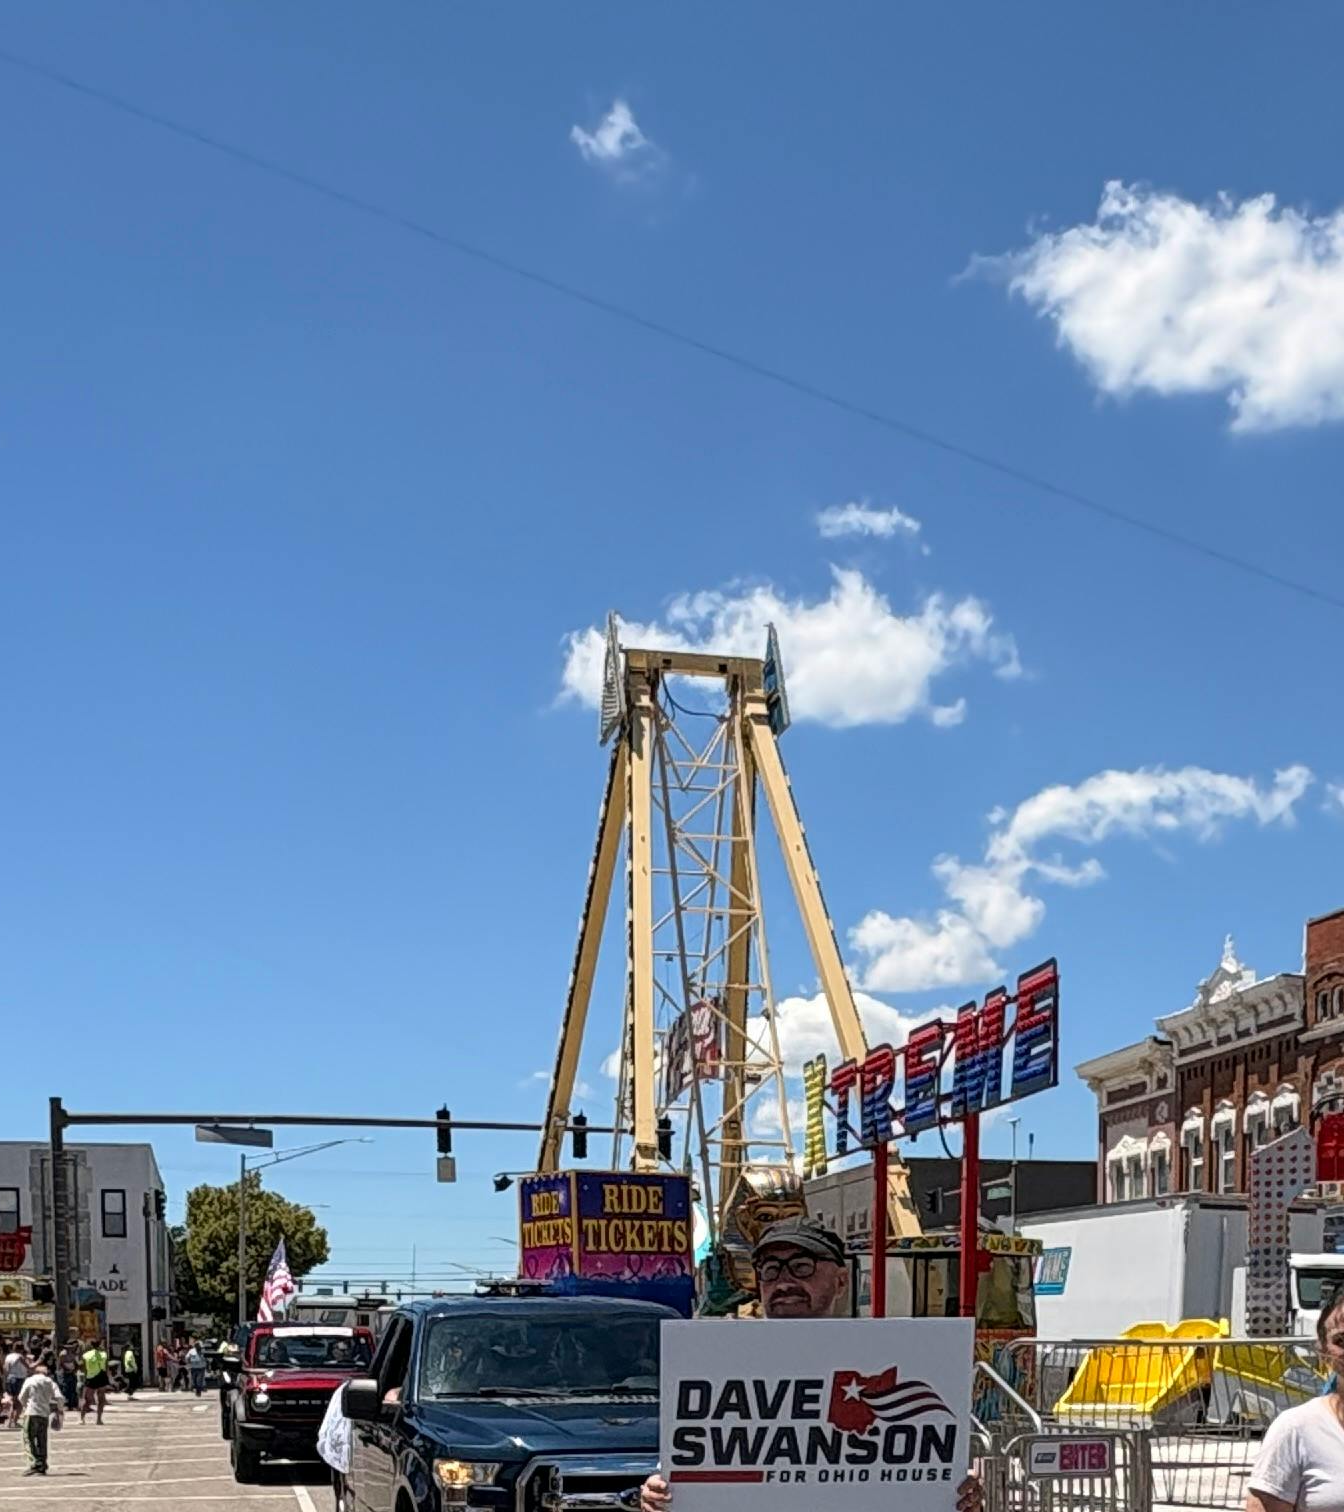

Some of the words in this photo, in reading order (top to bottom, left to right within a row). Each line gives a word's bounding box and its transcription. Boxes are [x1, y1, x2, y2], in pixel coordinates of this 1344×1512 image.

[530, 1191, 559, 1217] RIDE
[603, 1184, 663, 1214] RIDE
[523, 1218, 572, 1248] TICKETS
[582, 1219, 688, 1251] TICKETS
[676, 1379, 824, 1420] DAVE
[671, 1424, 957, 1466] SWANSON
[766, 1470, 806, 1483] FOR
[818, 1469, 869, 1482] OHIO
[880, 1468, 953, 1482] HOUSE
